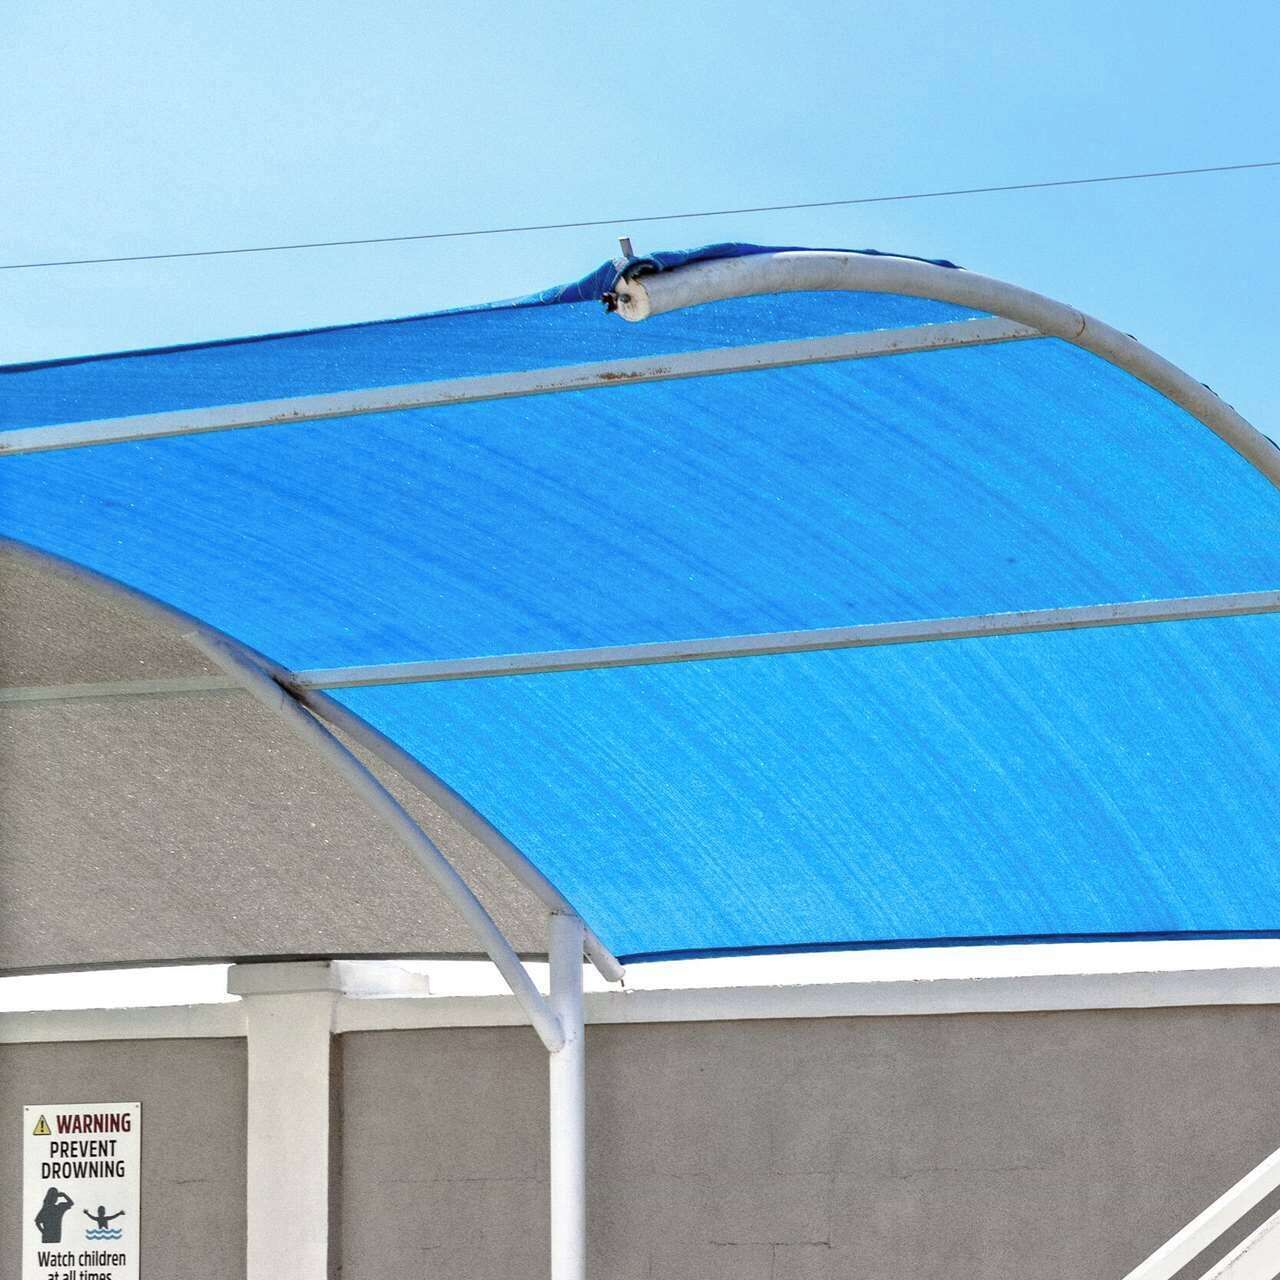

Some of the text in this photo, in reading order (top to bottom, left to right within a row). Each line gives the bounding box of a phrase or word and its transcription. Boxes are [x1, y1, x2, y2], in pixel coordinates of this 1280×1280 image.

[56, 1113, 131, 1134] WARNING
[50, 1140, 117, 1158] PREVENT
[41, 1161, 125, 1179] DROWNING
[38, 1251, 126, 1267] Watch children
